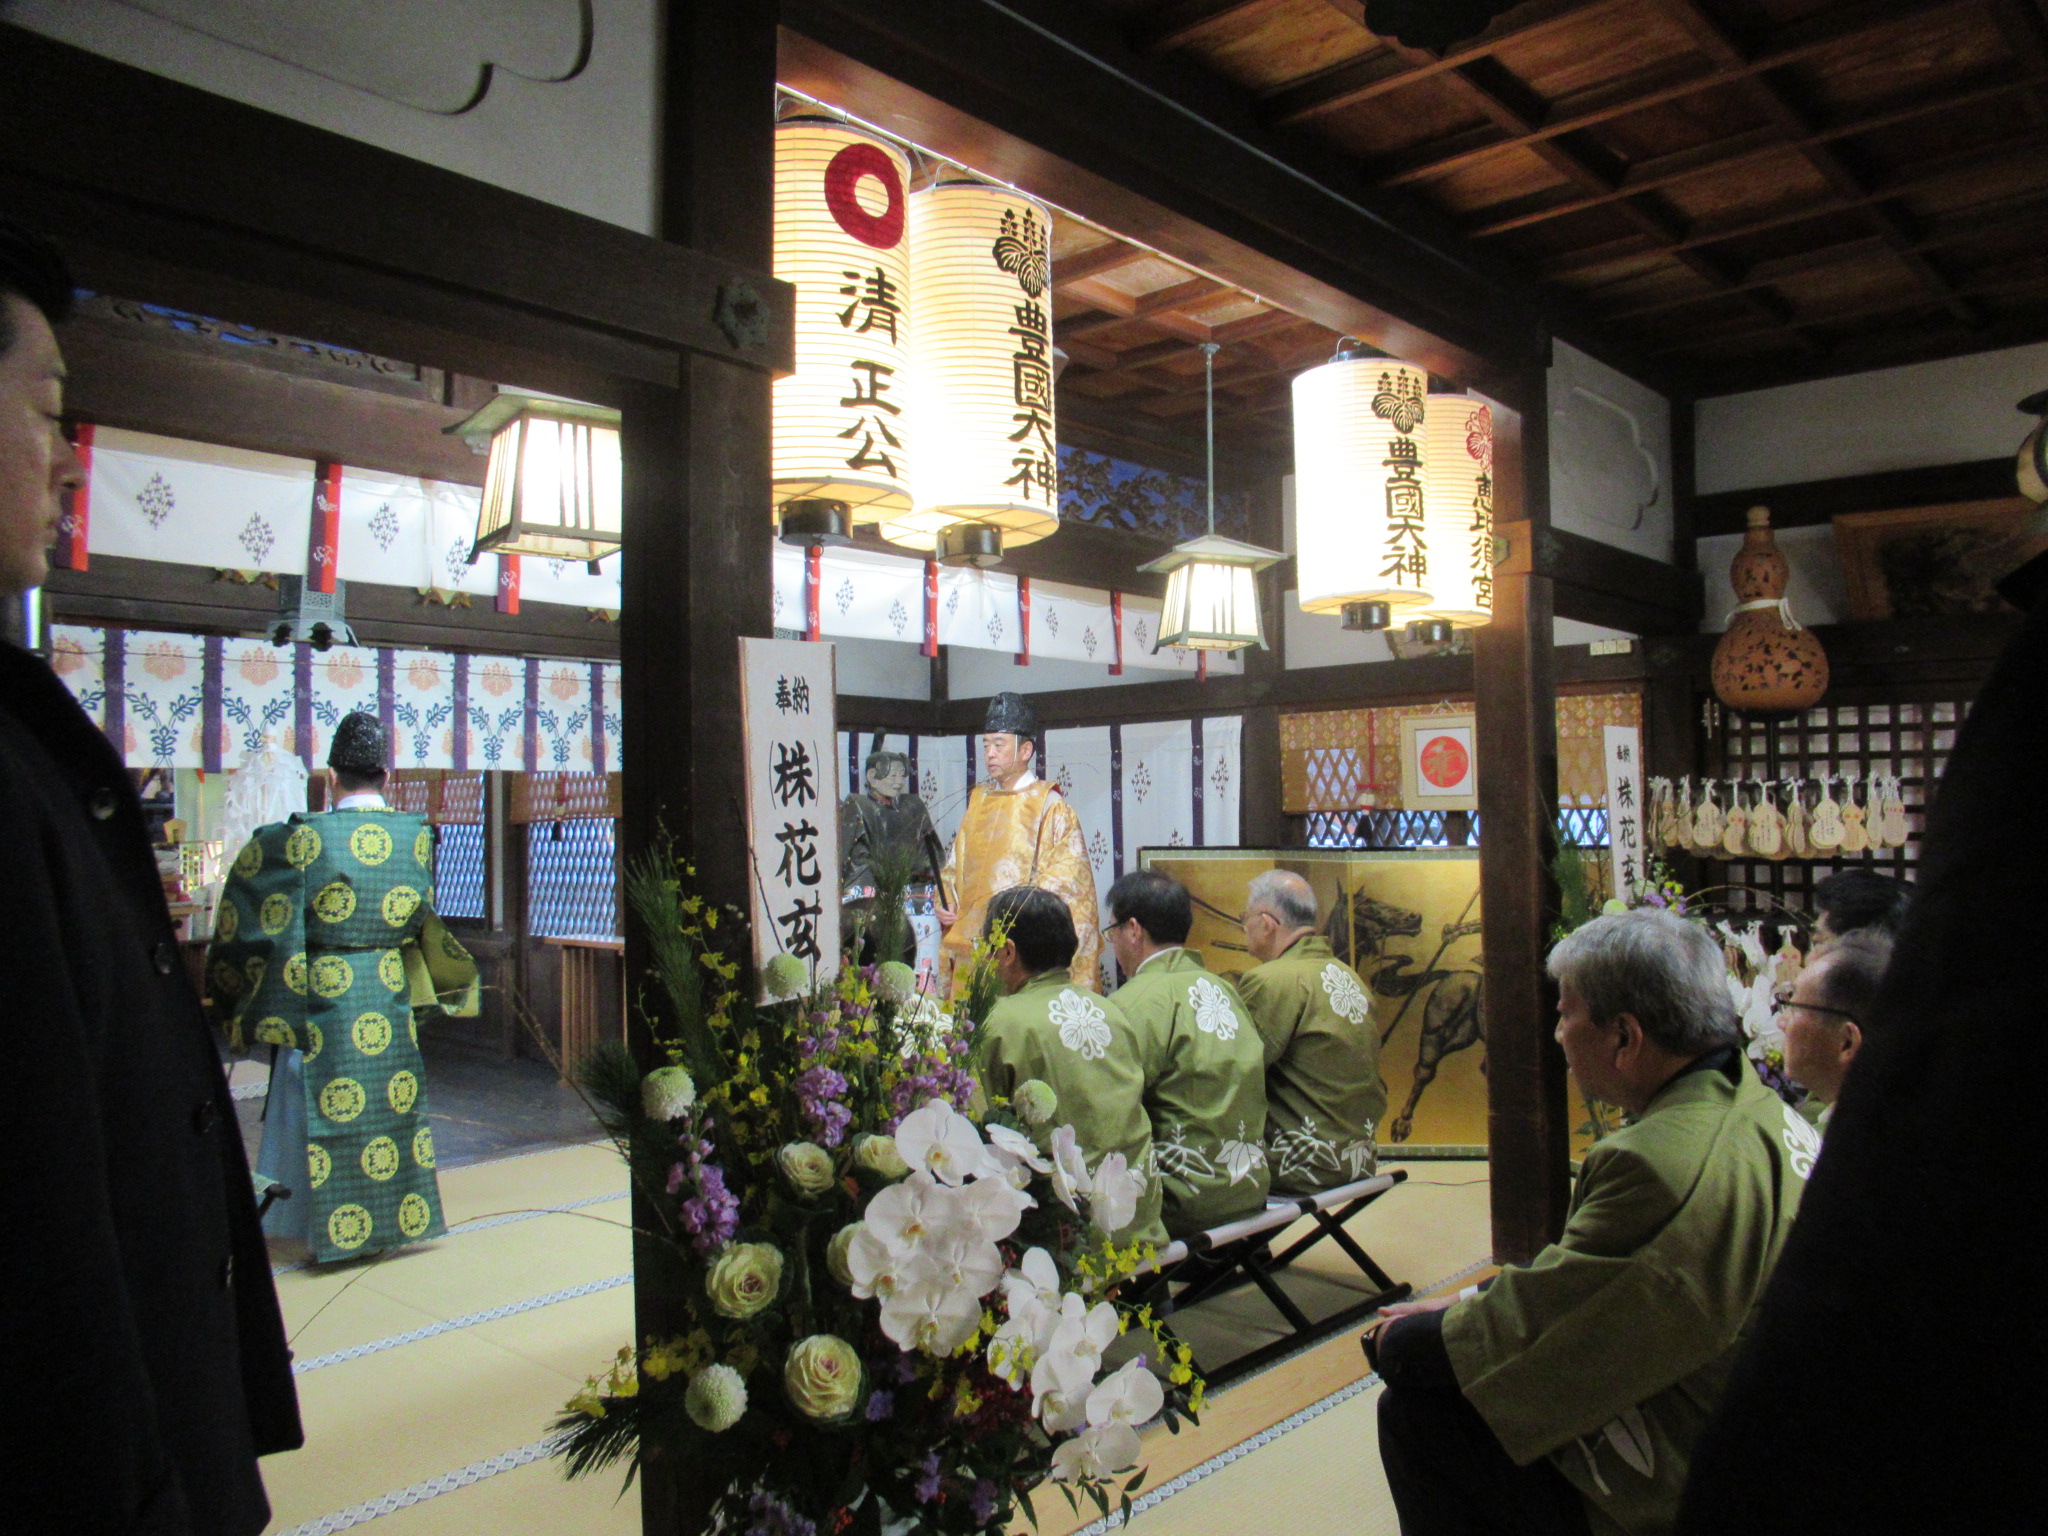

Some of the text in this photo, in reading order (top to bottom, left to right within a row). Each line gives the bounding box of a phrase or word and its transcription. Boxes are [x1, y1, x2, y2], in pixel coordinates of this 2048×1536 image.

[836, 266, 902, 479] 清正公
[1003, 299, 1057, 507] 豊國大神
[1379, 436, 1428, 588] 豊國大神
[774, 674, 810, 716] 奉納
